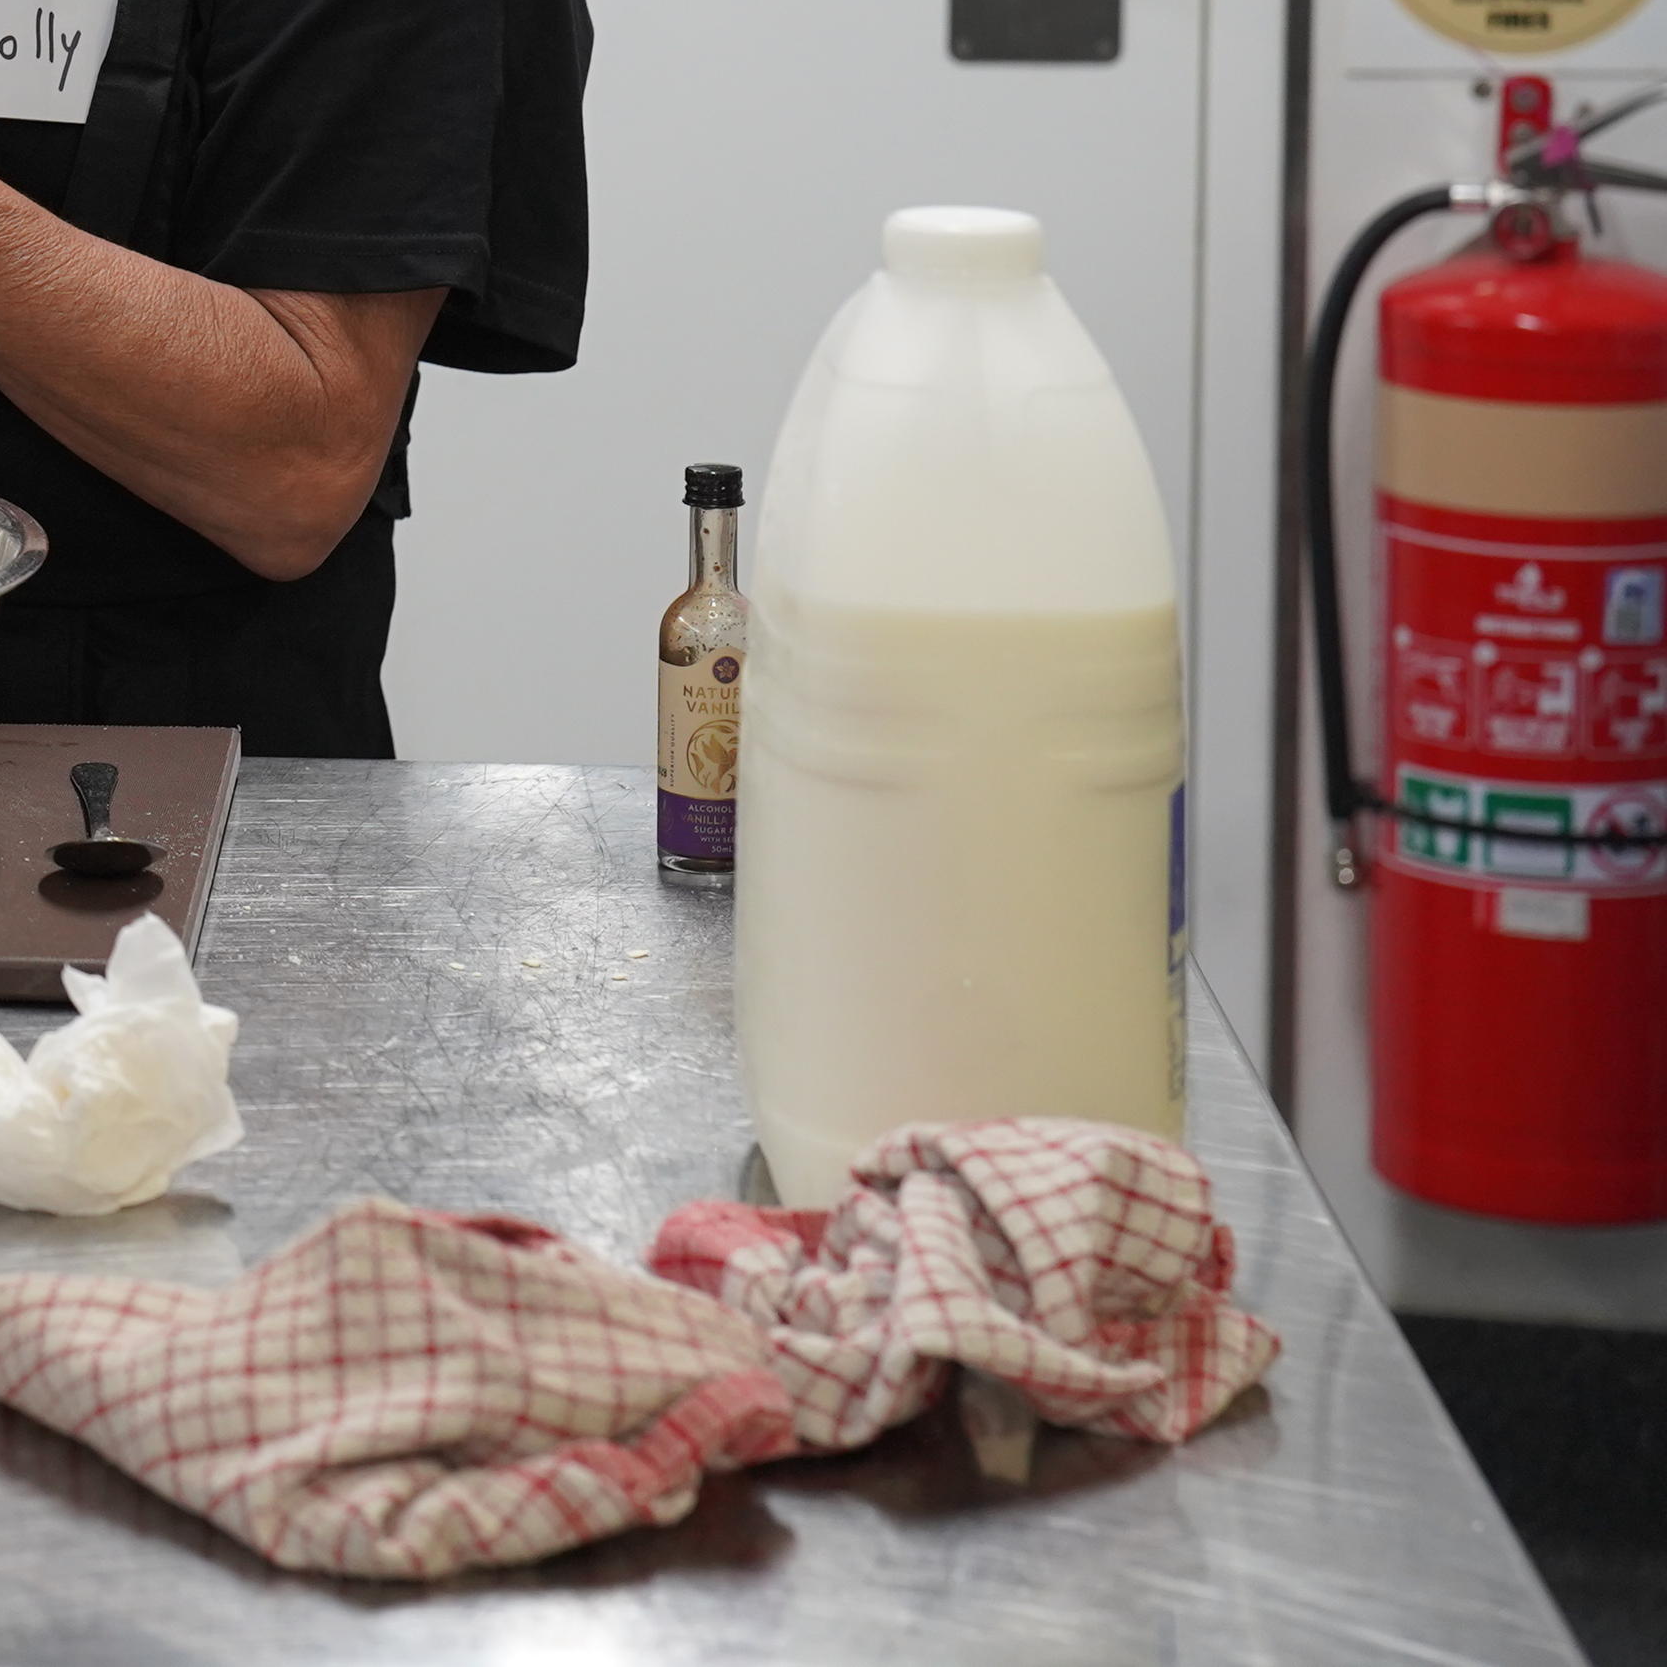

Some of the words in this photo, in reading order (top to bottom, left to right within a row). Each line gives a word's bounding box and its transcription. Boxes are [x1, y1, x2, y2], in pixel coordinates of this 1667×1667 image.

[683, 684, 740, 700] NATUR
[686, 700, 740, 715] VANIL
[688, 804, 733, 814] ALCOHOL
[694, 825, 727, 834] SUGAR
